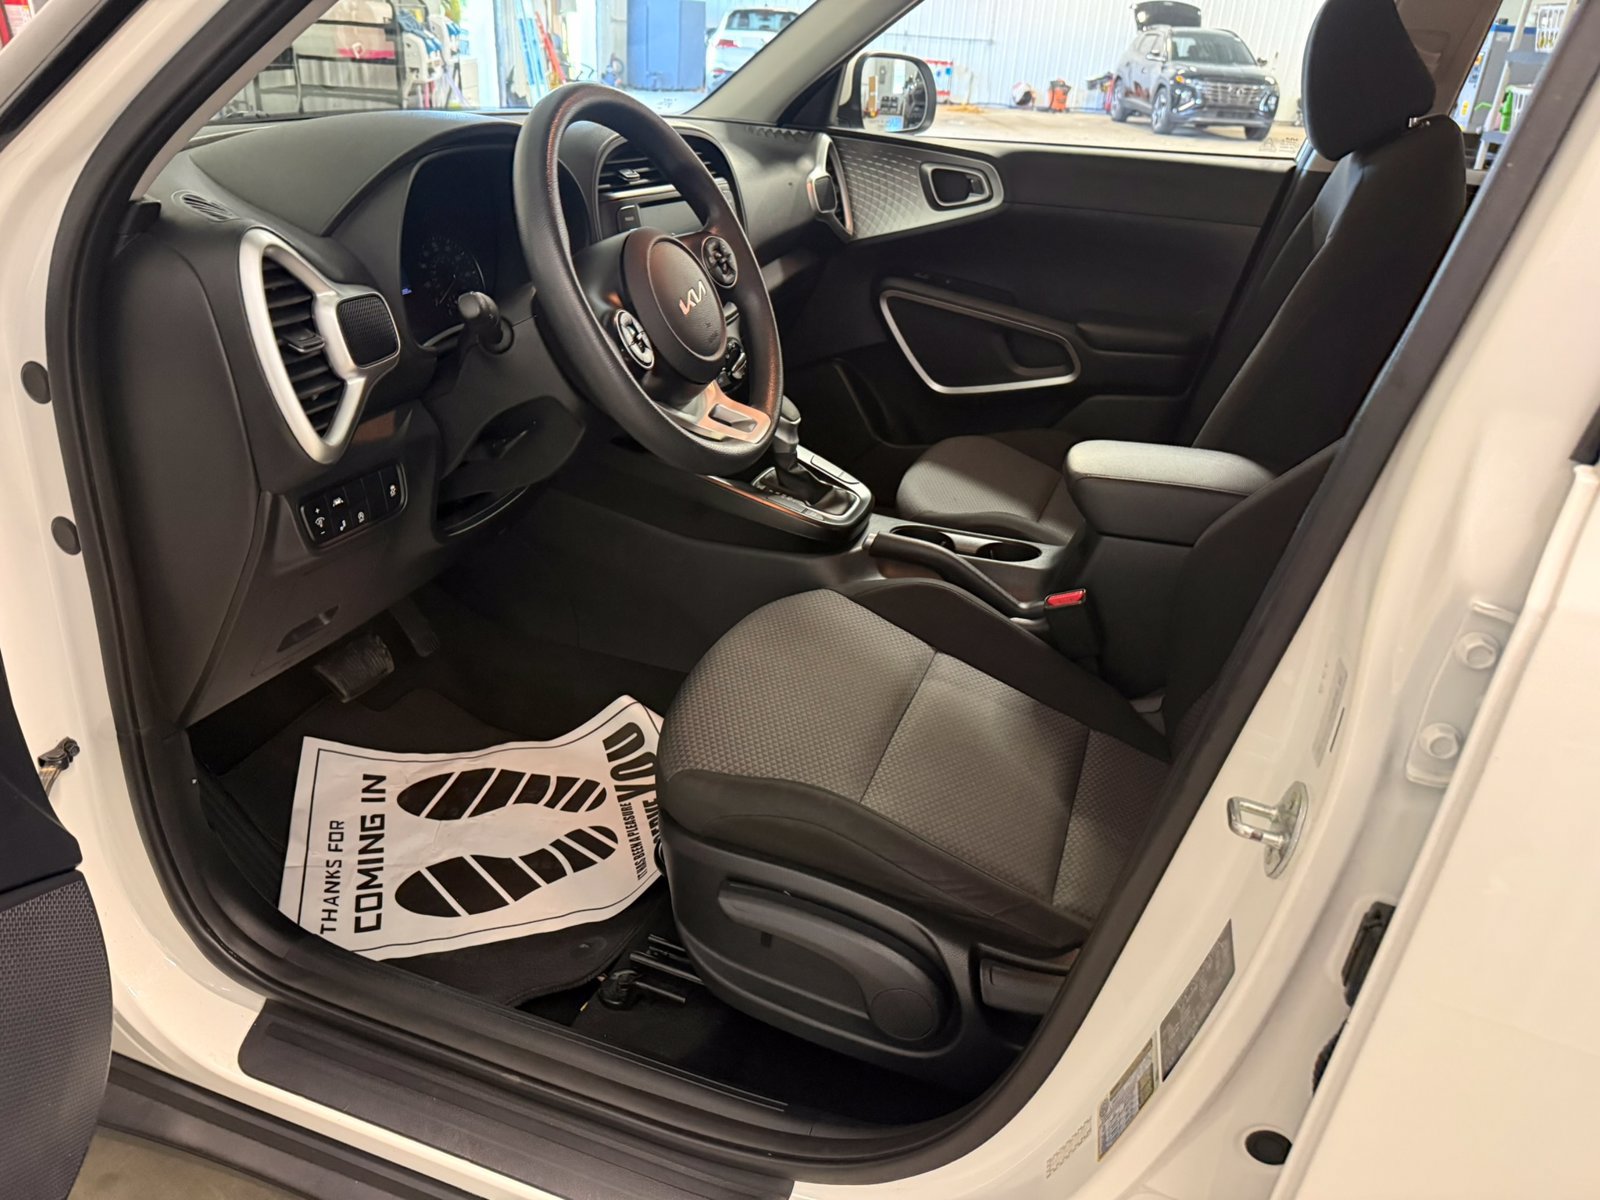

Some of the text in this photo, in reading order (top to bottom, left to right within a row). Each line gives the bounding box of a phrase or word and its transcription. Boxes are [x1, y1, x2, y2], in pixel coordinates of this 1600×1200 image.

[603, 722, 656, 802] YOU
[620, 802, 639, 837] PLEASURE
[354, 773, 386, 934] COMING IN
[631, 842, 645, 860] BEEN
[634, 857, 646, 872] HAS
[320, 820, 345, 934] THANKS FOR
[636, 869, 647, 880] IT
